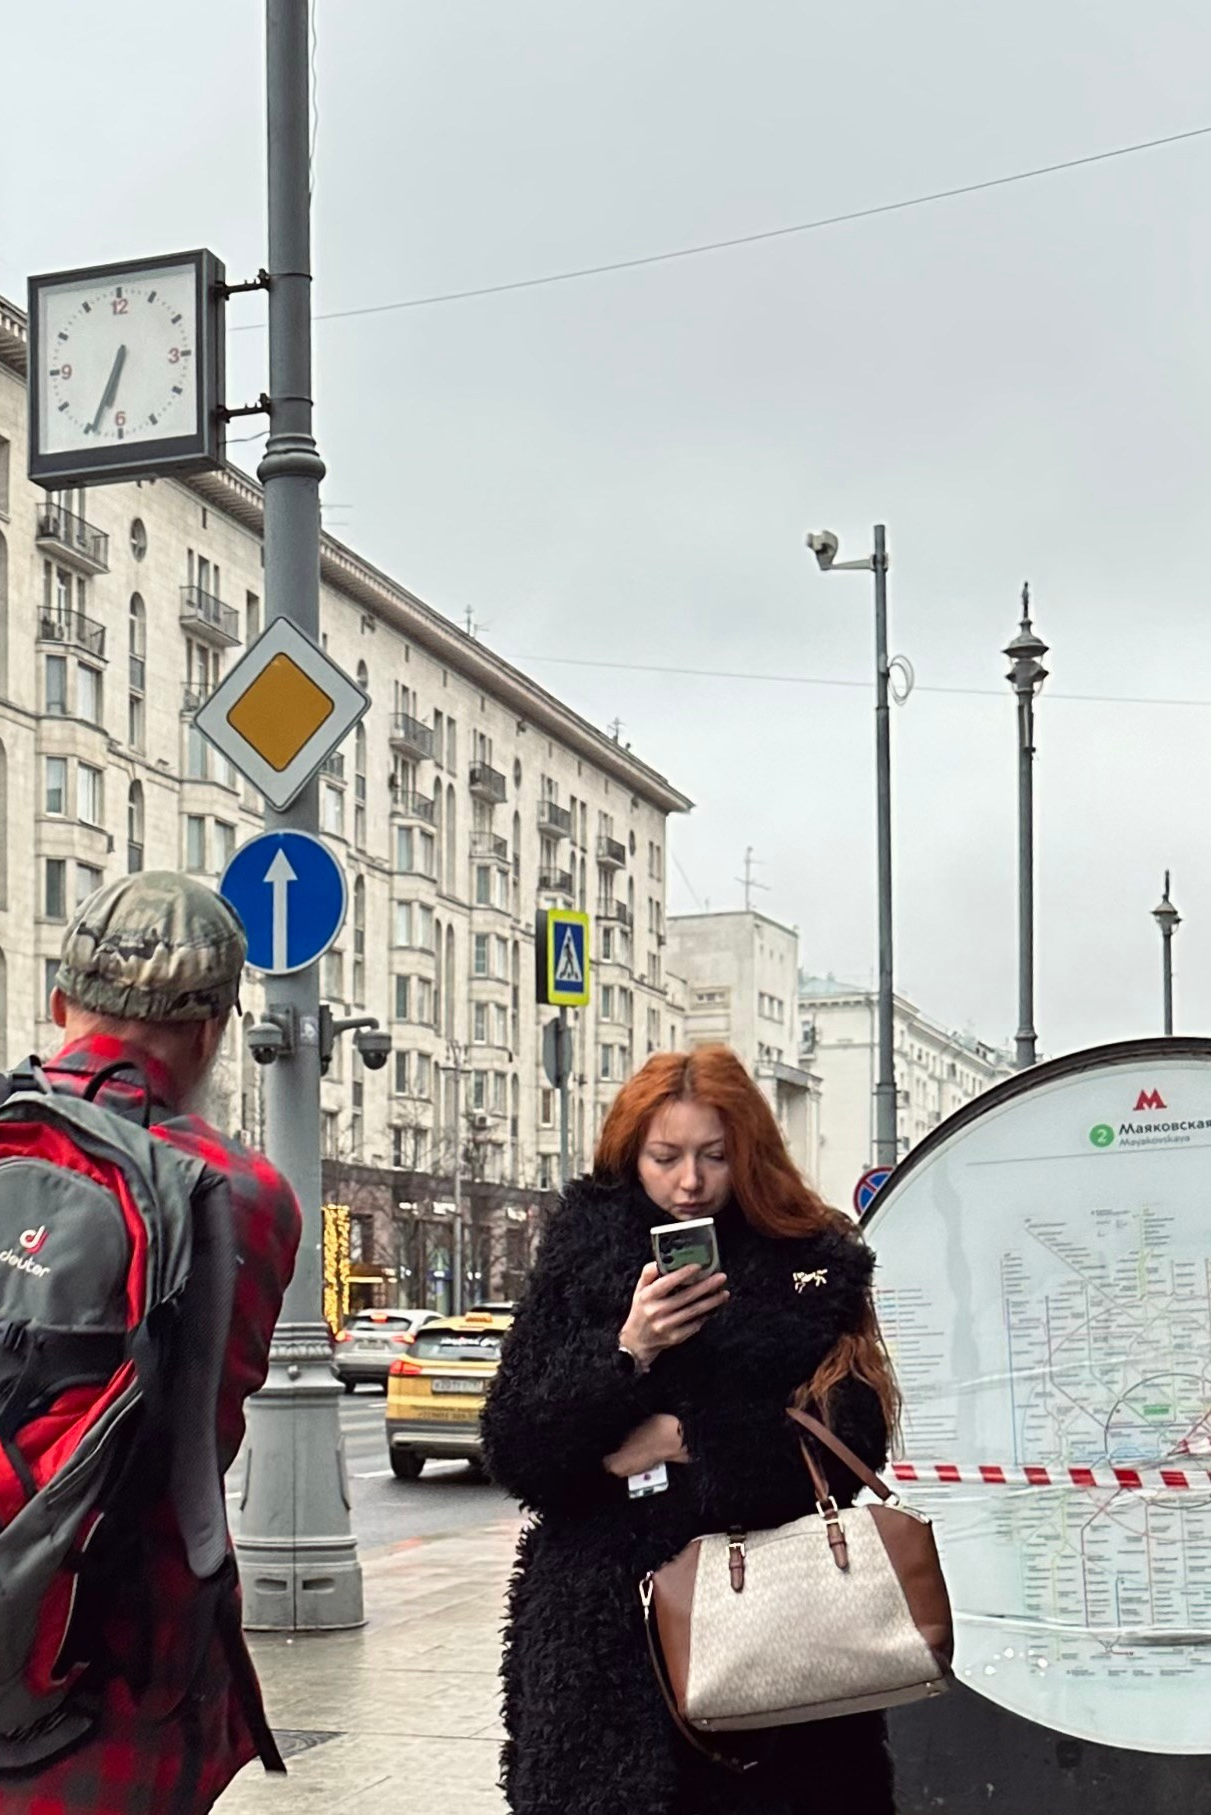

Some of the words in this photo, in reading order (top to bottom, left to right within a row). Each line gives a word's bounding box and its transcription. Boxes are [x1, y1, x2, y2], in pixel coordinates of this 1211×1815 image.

[111, 298, 128, 316] 12
[168, 347, 180, 364] 3
[61, 364, 73, 380] 9
[114, 410, 126, 427] 6
[1096, 1128, 1107, 1143] 2
[1118, 1118, 1211, 1136] Маяковская
